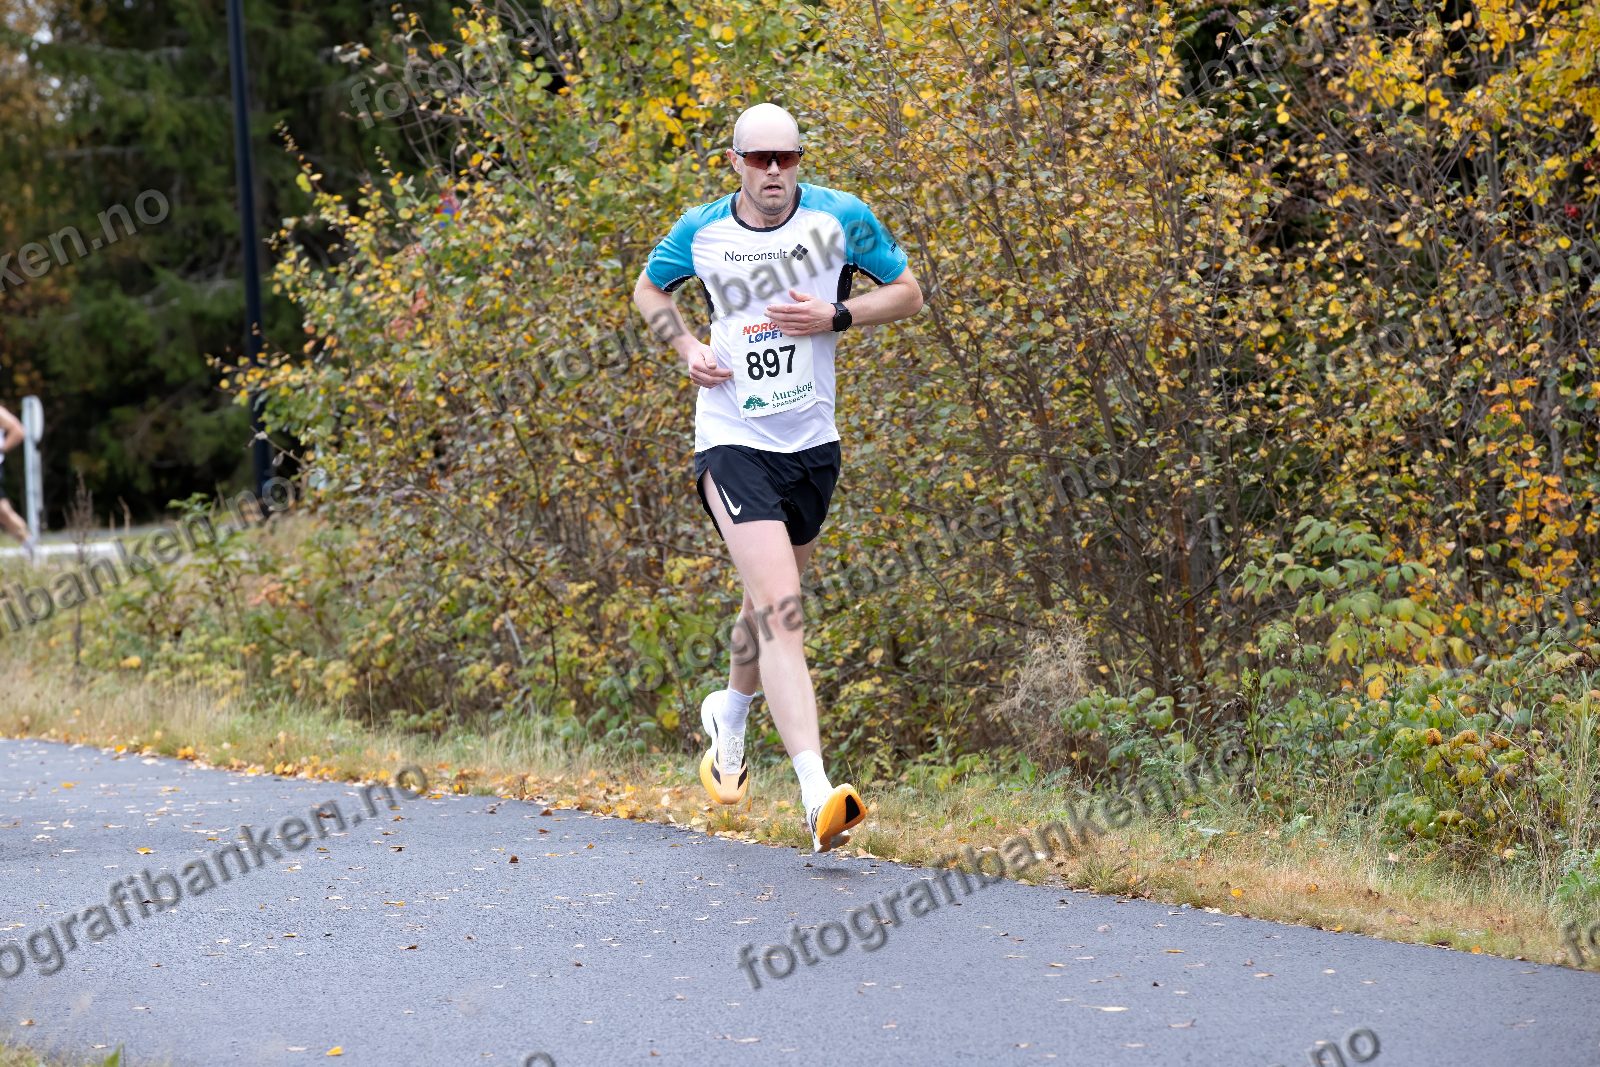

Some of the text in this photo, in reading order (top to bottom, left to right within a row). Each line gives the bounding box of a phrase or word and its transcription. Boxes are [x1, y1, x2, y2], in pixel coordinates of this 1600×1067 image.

[724, 248, 788, 262] Norconsult
[742, 321, 779, 336] NORG
[746, 344, 796, 381] 897
[772, 381, 813, 402] Aurskog
